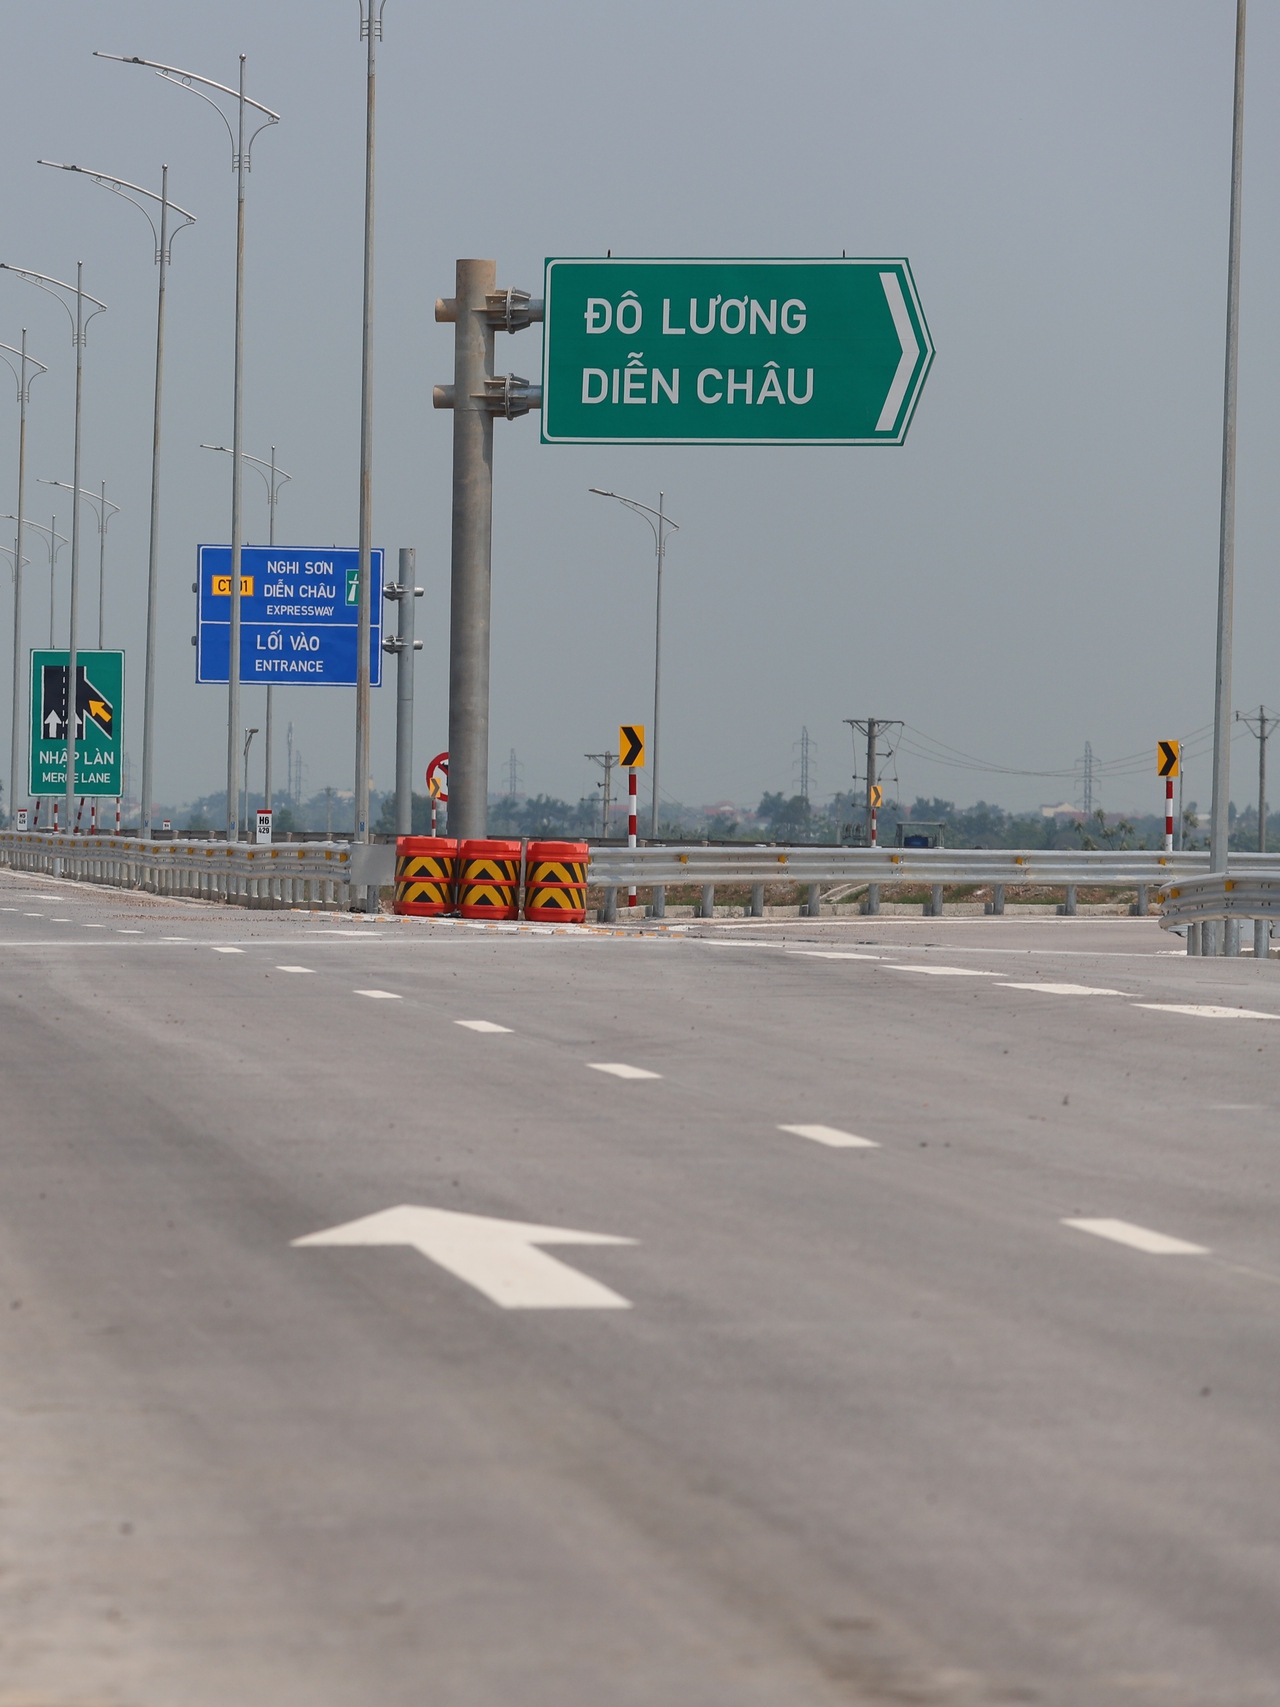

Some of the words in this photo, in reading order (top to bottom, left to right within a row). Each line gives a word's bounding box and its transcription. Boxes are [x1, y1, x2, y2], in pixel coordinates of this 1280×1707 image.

[584, 290, 643, 335] ĐÔ
[662, 294, 807, 335] LƯƠNG
[582, 352, 680, 404] DIỄN
[696, 361, 814, 404] CHÂU
[267, 561, 299, 574] NGHI
[305, 560, 334, 575] SƠN
[264, 579, 294, 598] DIỄN
[299, 582, 336, 598] CHÂU
[266, 605, 334, 616] EXPRESSWAY
[256, 630, 283, 650] LỐI
[290, 632, 320, 651] VÀO
[255, 660, 324, 672] ENTRANCE
[84, 748, 114, 765] LÀN
[42, 772, 79, 783] MERE
[81, 772, 111, 783] LANE
[259, 816, 269, 825] H6
